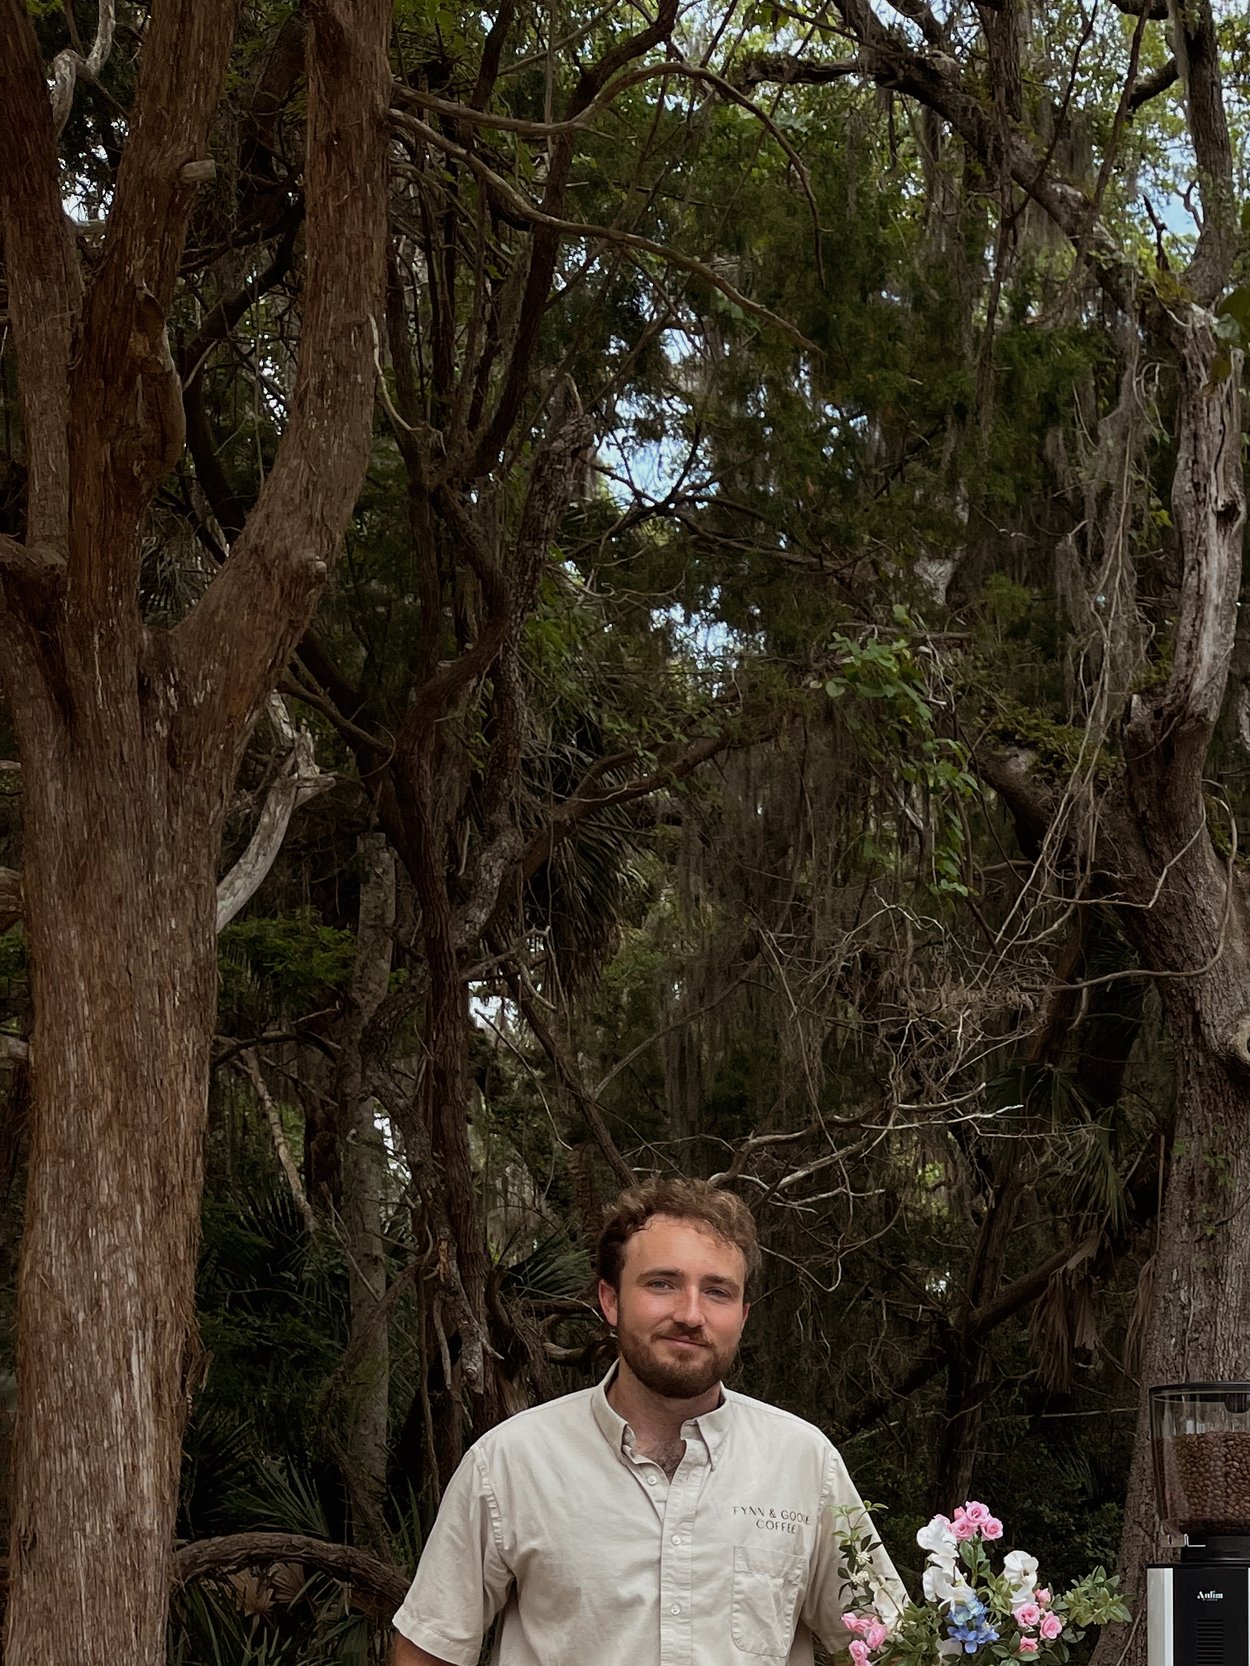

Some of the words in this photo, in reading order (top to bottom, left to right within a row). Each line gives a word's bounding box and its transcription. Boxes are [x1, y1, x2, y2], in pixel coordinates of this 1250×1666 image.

[733, 1506, 765, 1517] FYNN
[769, 1508, 777, 1518] &
[756, 1519, 797, 1534] COFFEE
